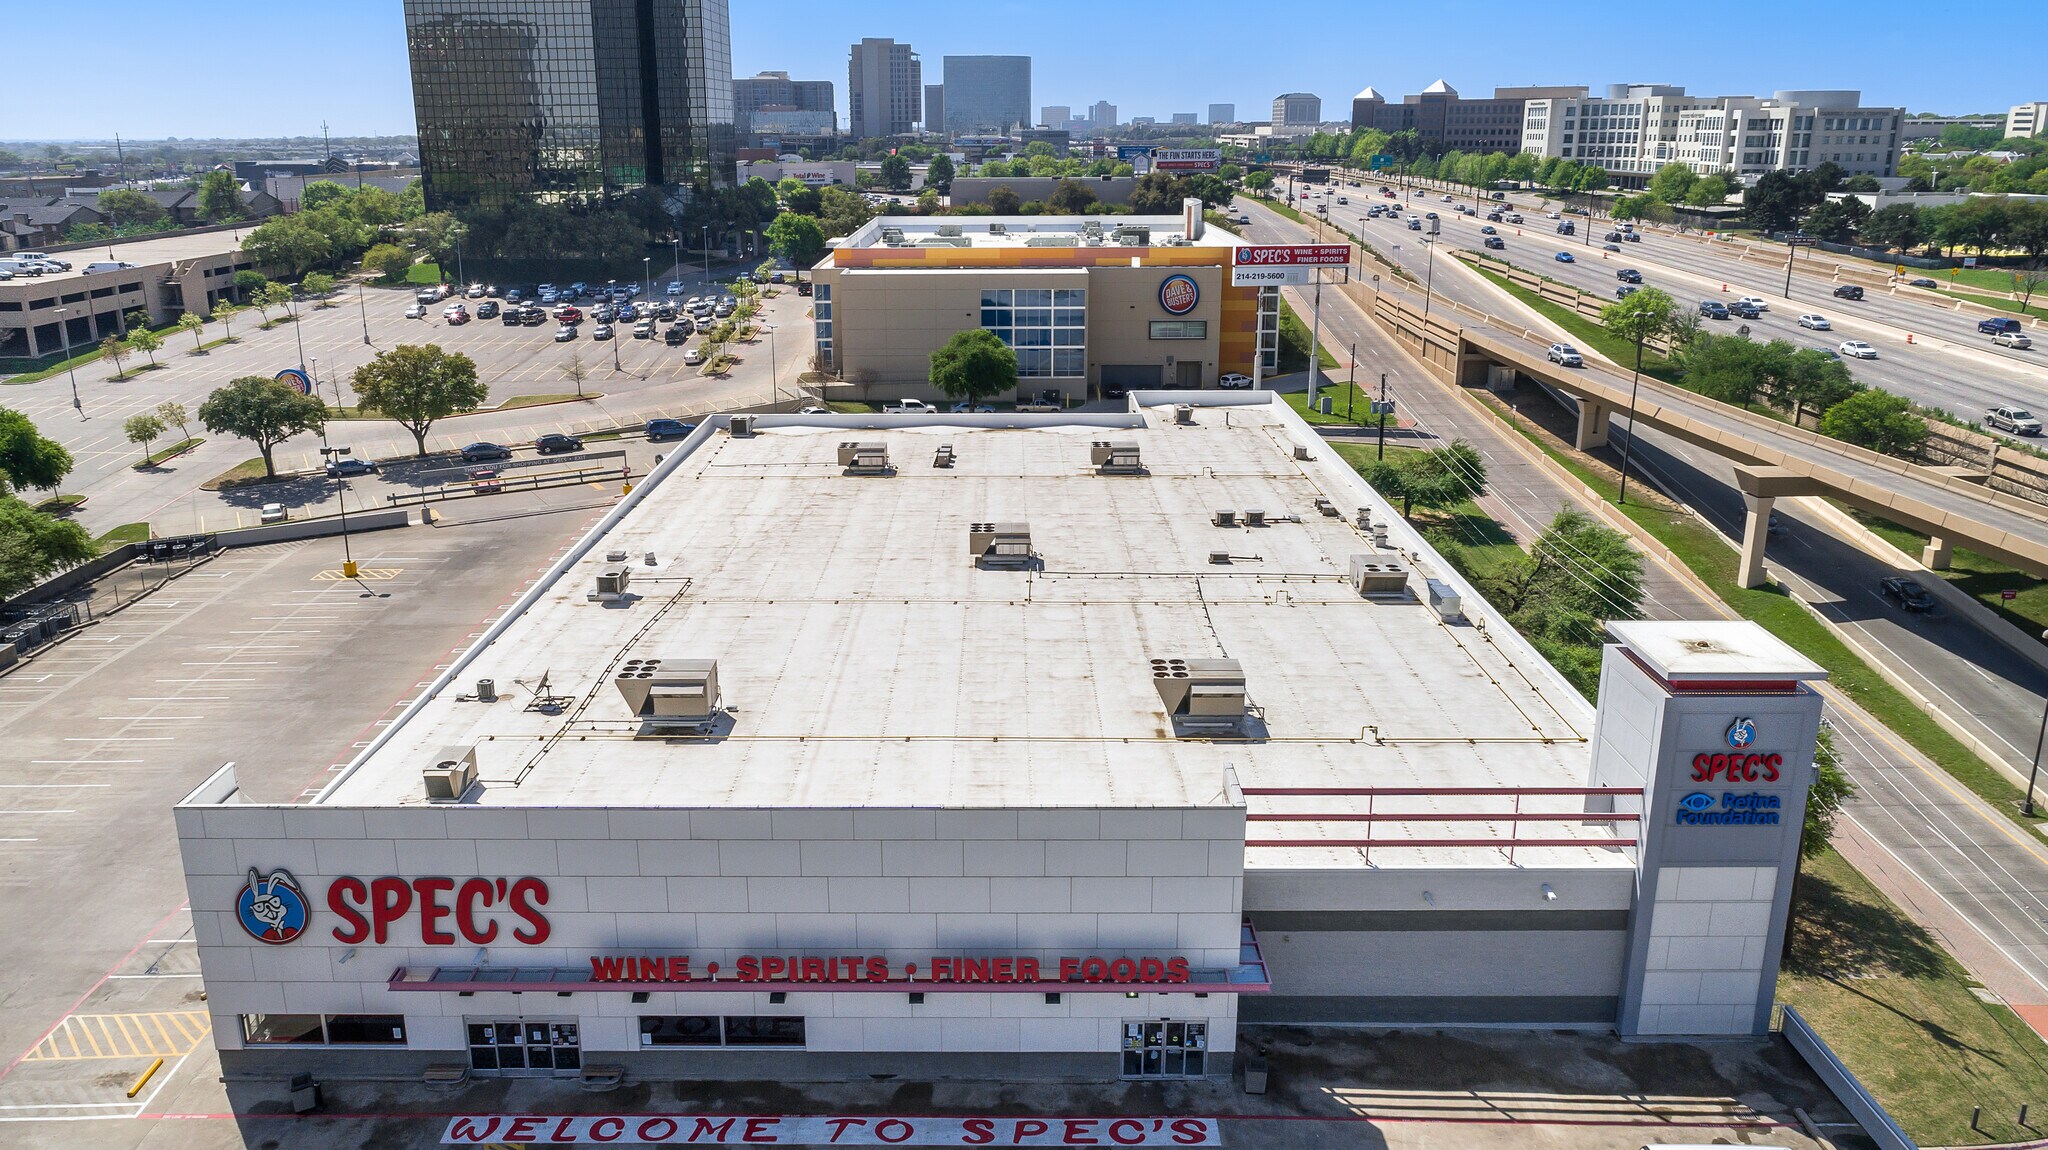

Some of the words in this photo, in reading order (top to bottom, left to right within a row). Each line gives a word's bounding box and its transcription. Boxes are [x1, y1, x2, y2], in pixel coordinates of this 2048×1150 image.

[1159, 151, 1168, 160] THE
[1169, 151, 1180, 160] FUN
[1181, 151, 1200, 160] STARTS
[1202, 150, 1215, 159] HERE
[1253, 249, 1291, 263] SPEC'S
[1236, 272, 1285, 280] 214-219-5600
[1165, 284, 1187, 298] DAVE
[1186, 284, 1193, 293] &
[1166, 293, 1194, 307] BUSTER'S
[513, 460, 542, 468] SHOPPING
[1691, 753, 1782, 782] SPEC'S
[1721, 792, 1781, 809] Retina
[1676, 808, 1780, 825] Foundation
[327, 876, 551, 945] SPEC'S
[590, 955, 692, 982] WINE
[736, 955, 889, 982] SPIRITS
[931, 956, 1040, 983] FINER
[1059, 955, 1190, 983] FOODS
[450, 1117, 778, 1143] WELCOME
[825, 1118, 914, 1143] TO
[961, 1119, 1208, 1145] SPEC'S
